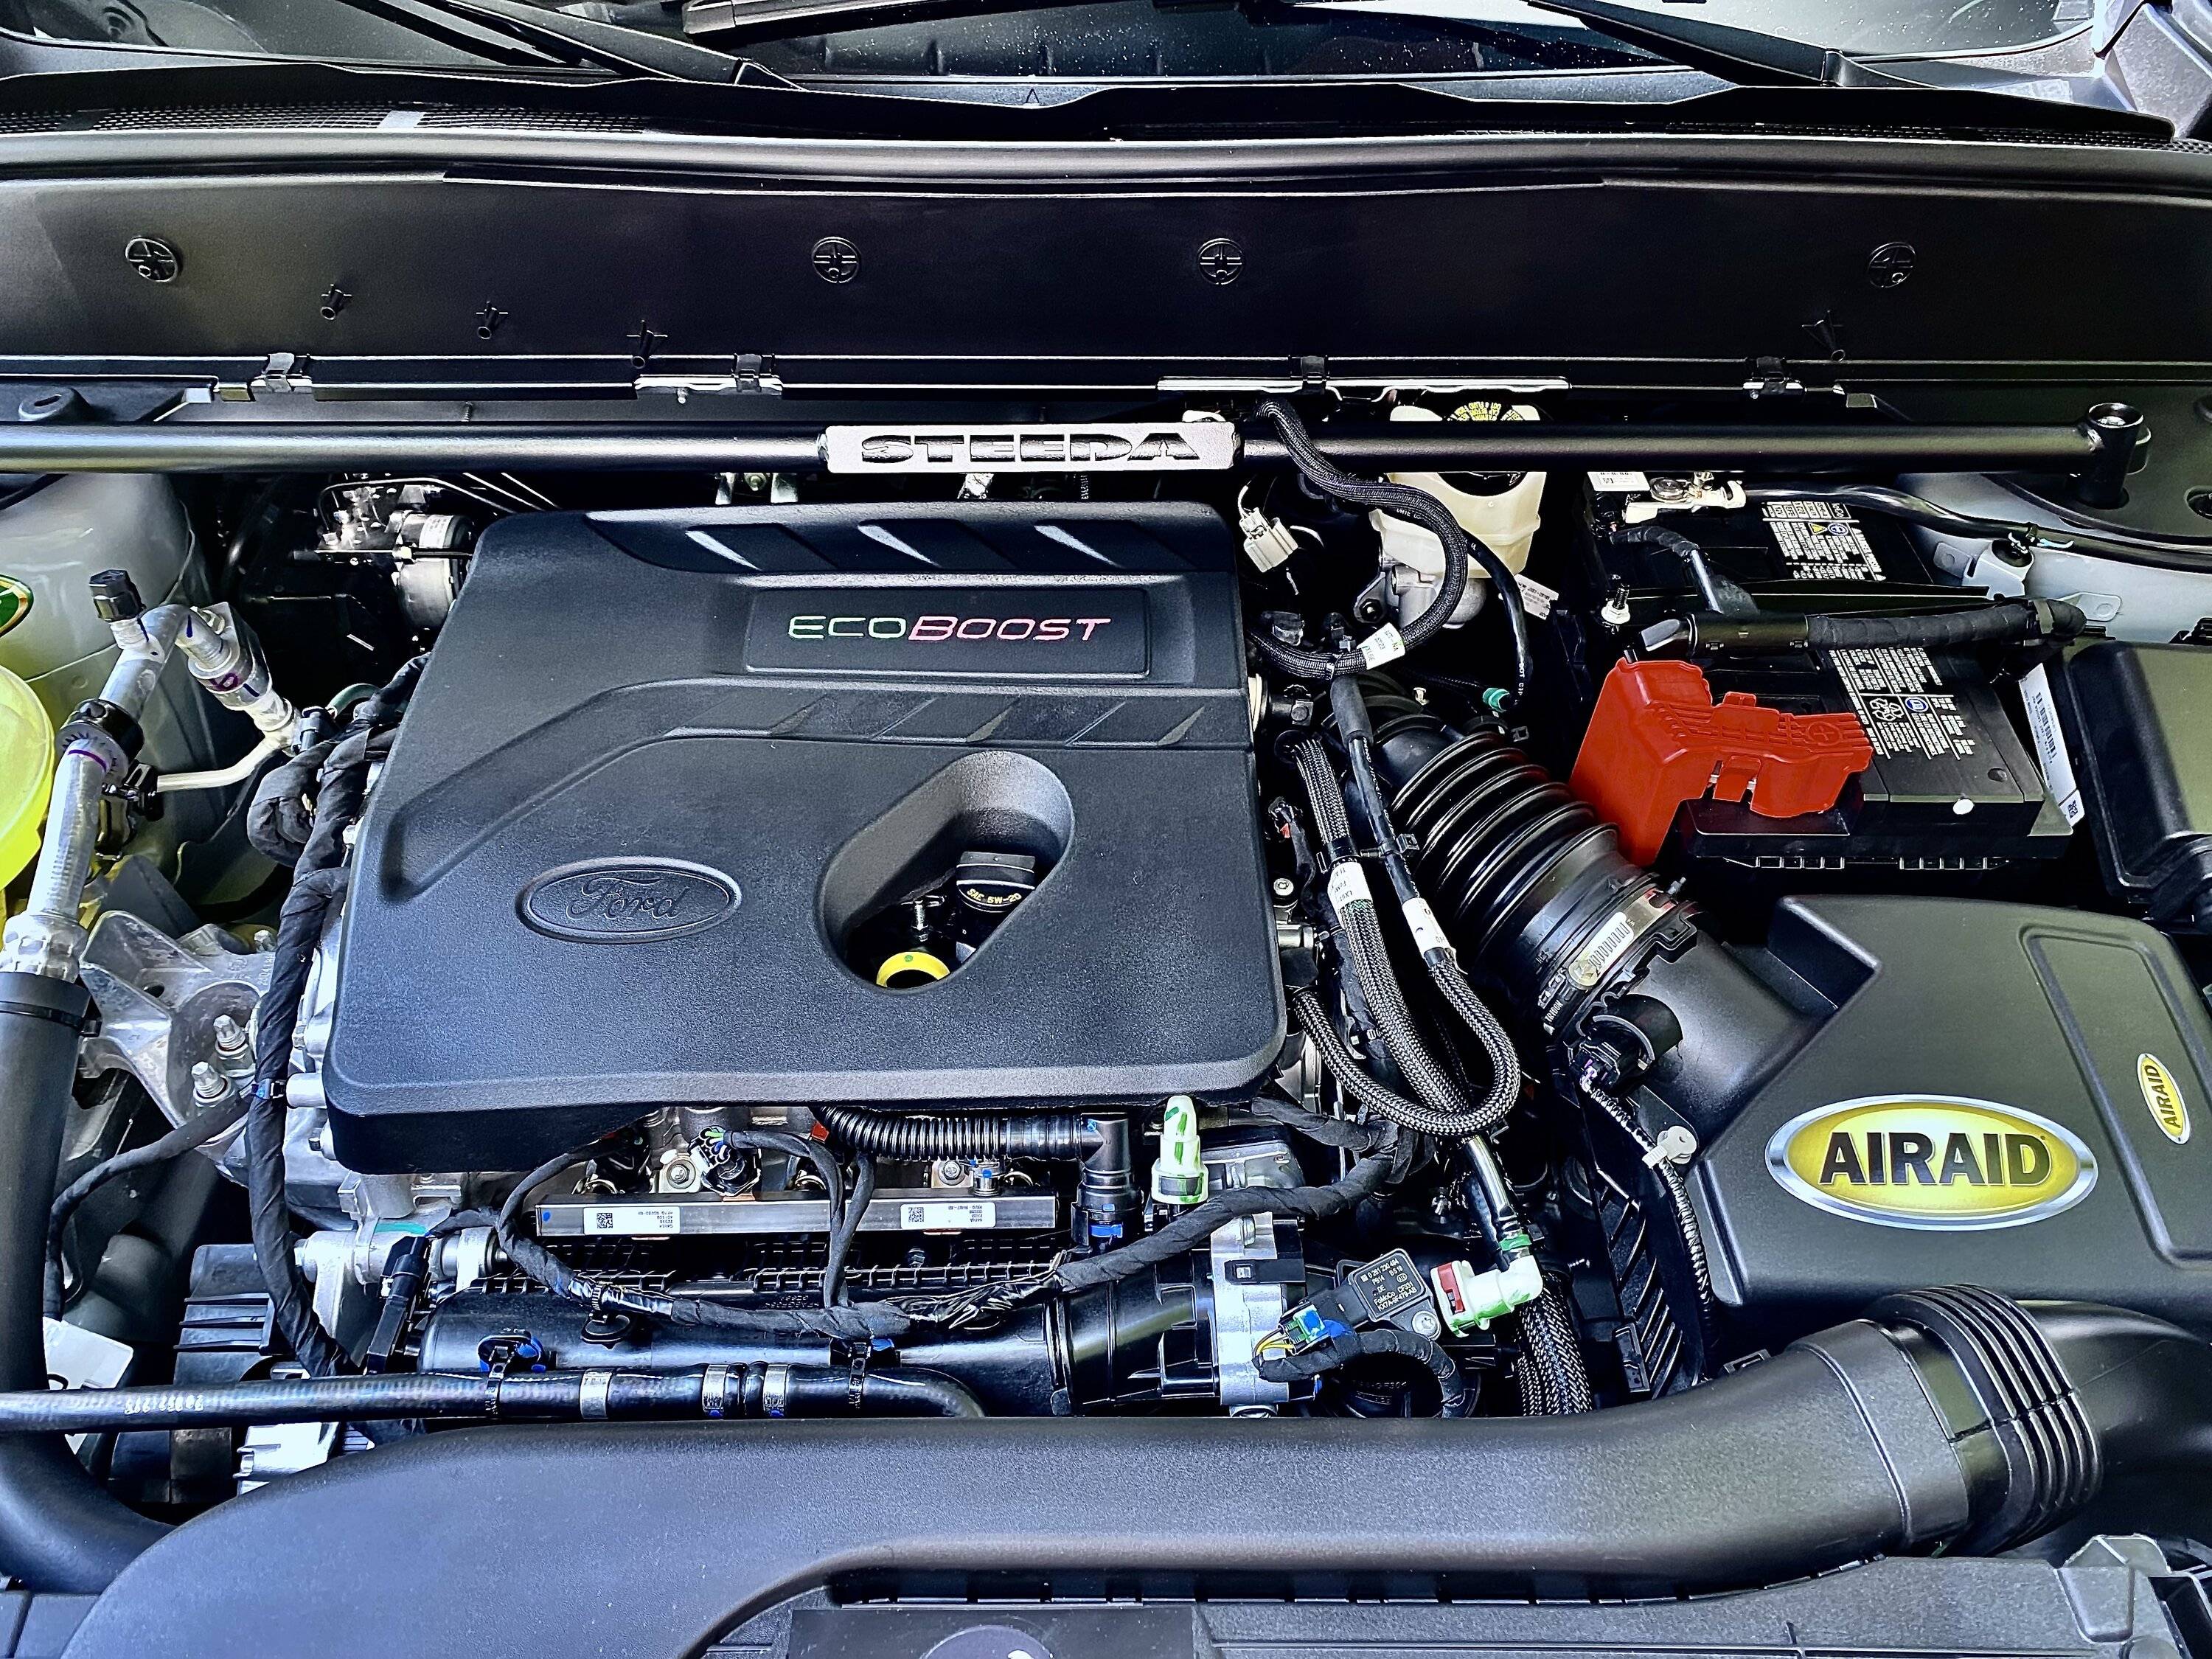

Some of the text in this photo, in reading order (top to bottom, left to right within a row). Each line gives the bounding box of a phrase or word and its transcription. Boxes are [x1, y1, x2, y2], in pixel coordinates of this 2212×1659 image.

[861, 432, 1200, 464] STEEDA
[788, 615, 1112, 641] ECOBOOST
[566, 877, 692, 921] Ford
[967, 888, 1022, 904] SAE 5W-20
[1544, 999, 1564, 1025] TRIDON
[2144, 1065, 2181, 1129] AIRAID
[1818, 1132, 2052, 1186] AIRAID
[1373, 1291, 1396, 1306] FoMoCo
